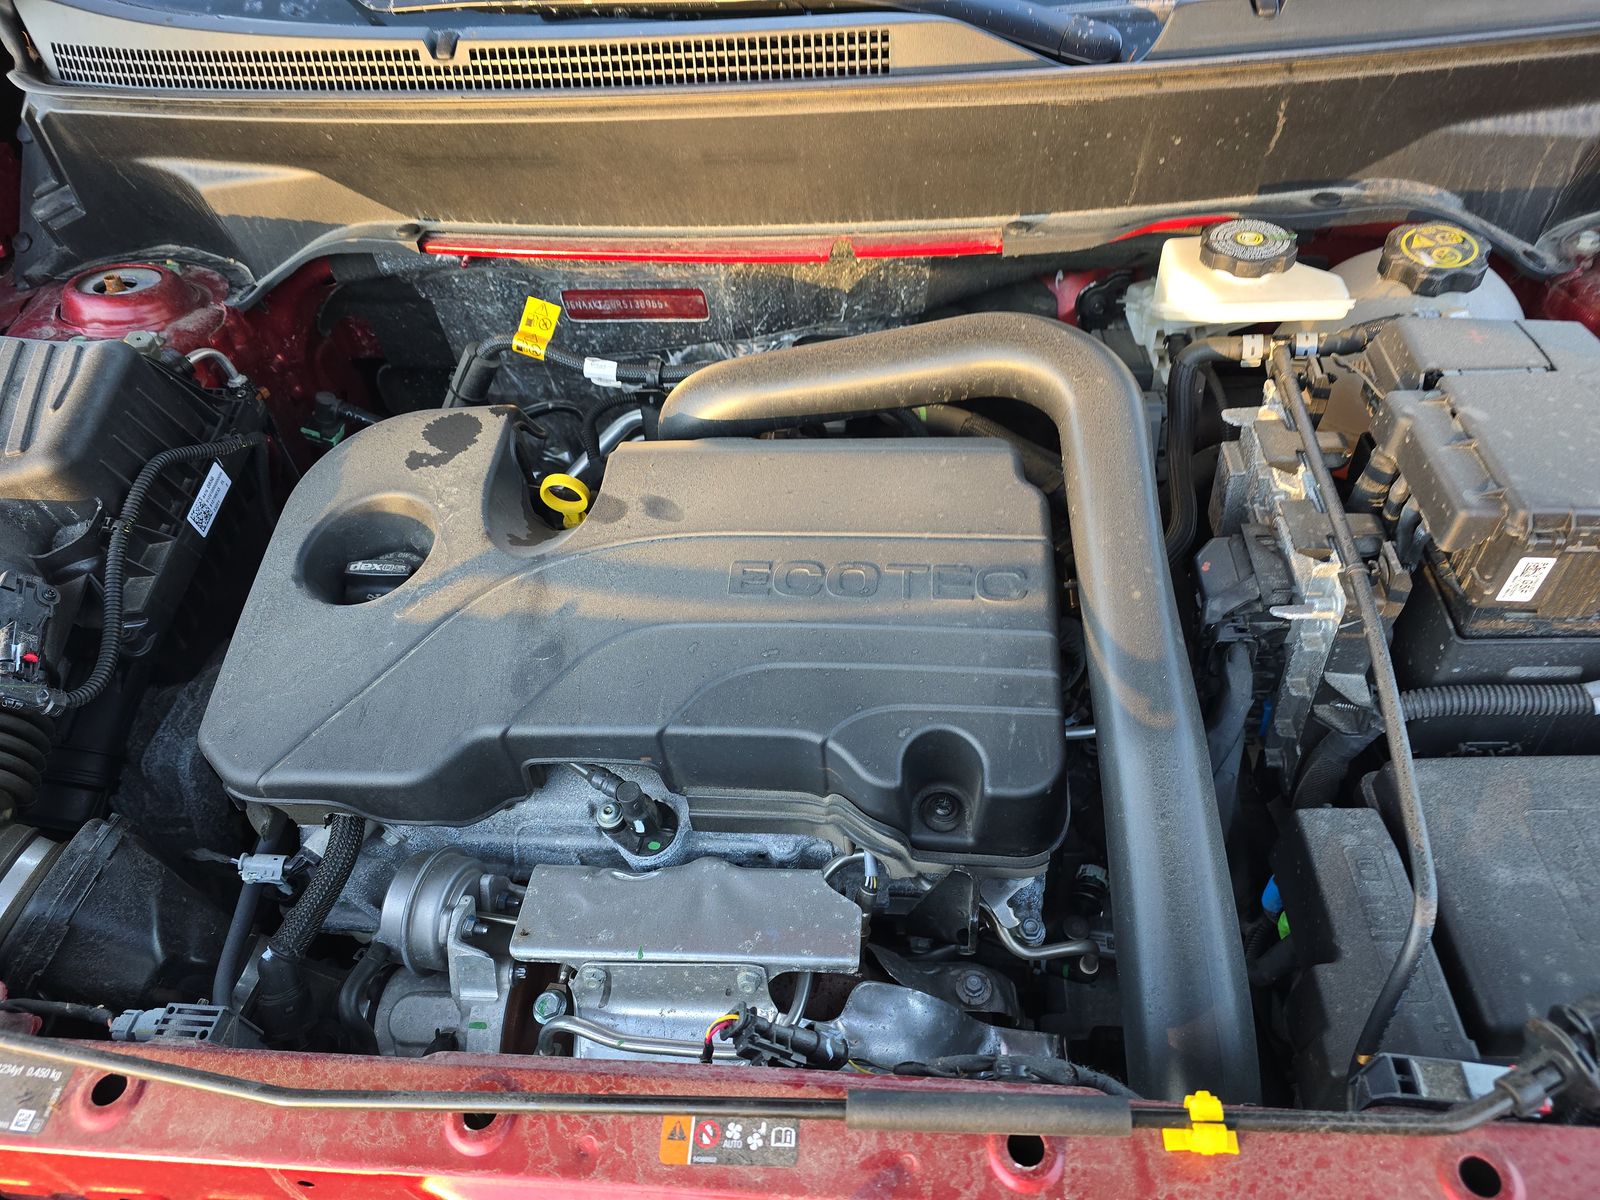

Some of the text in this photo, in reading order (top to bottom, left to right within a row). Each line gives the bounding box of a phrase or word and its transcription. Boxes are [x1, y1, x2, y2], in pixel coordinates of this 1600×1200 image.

[349, 561, 406, 573] dexos
[727, 559, 1029, 602] ECOTEC
[49, 1069, 62, 1082] kg
[722, 1139, 743, 1149] AUTO
